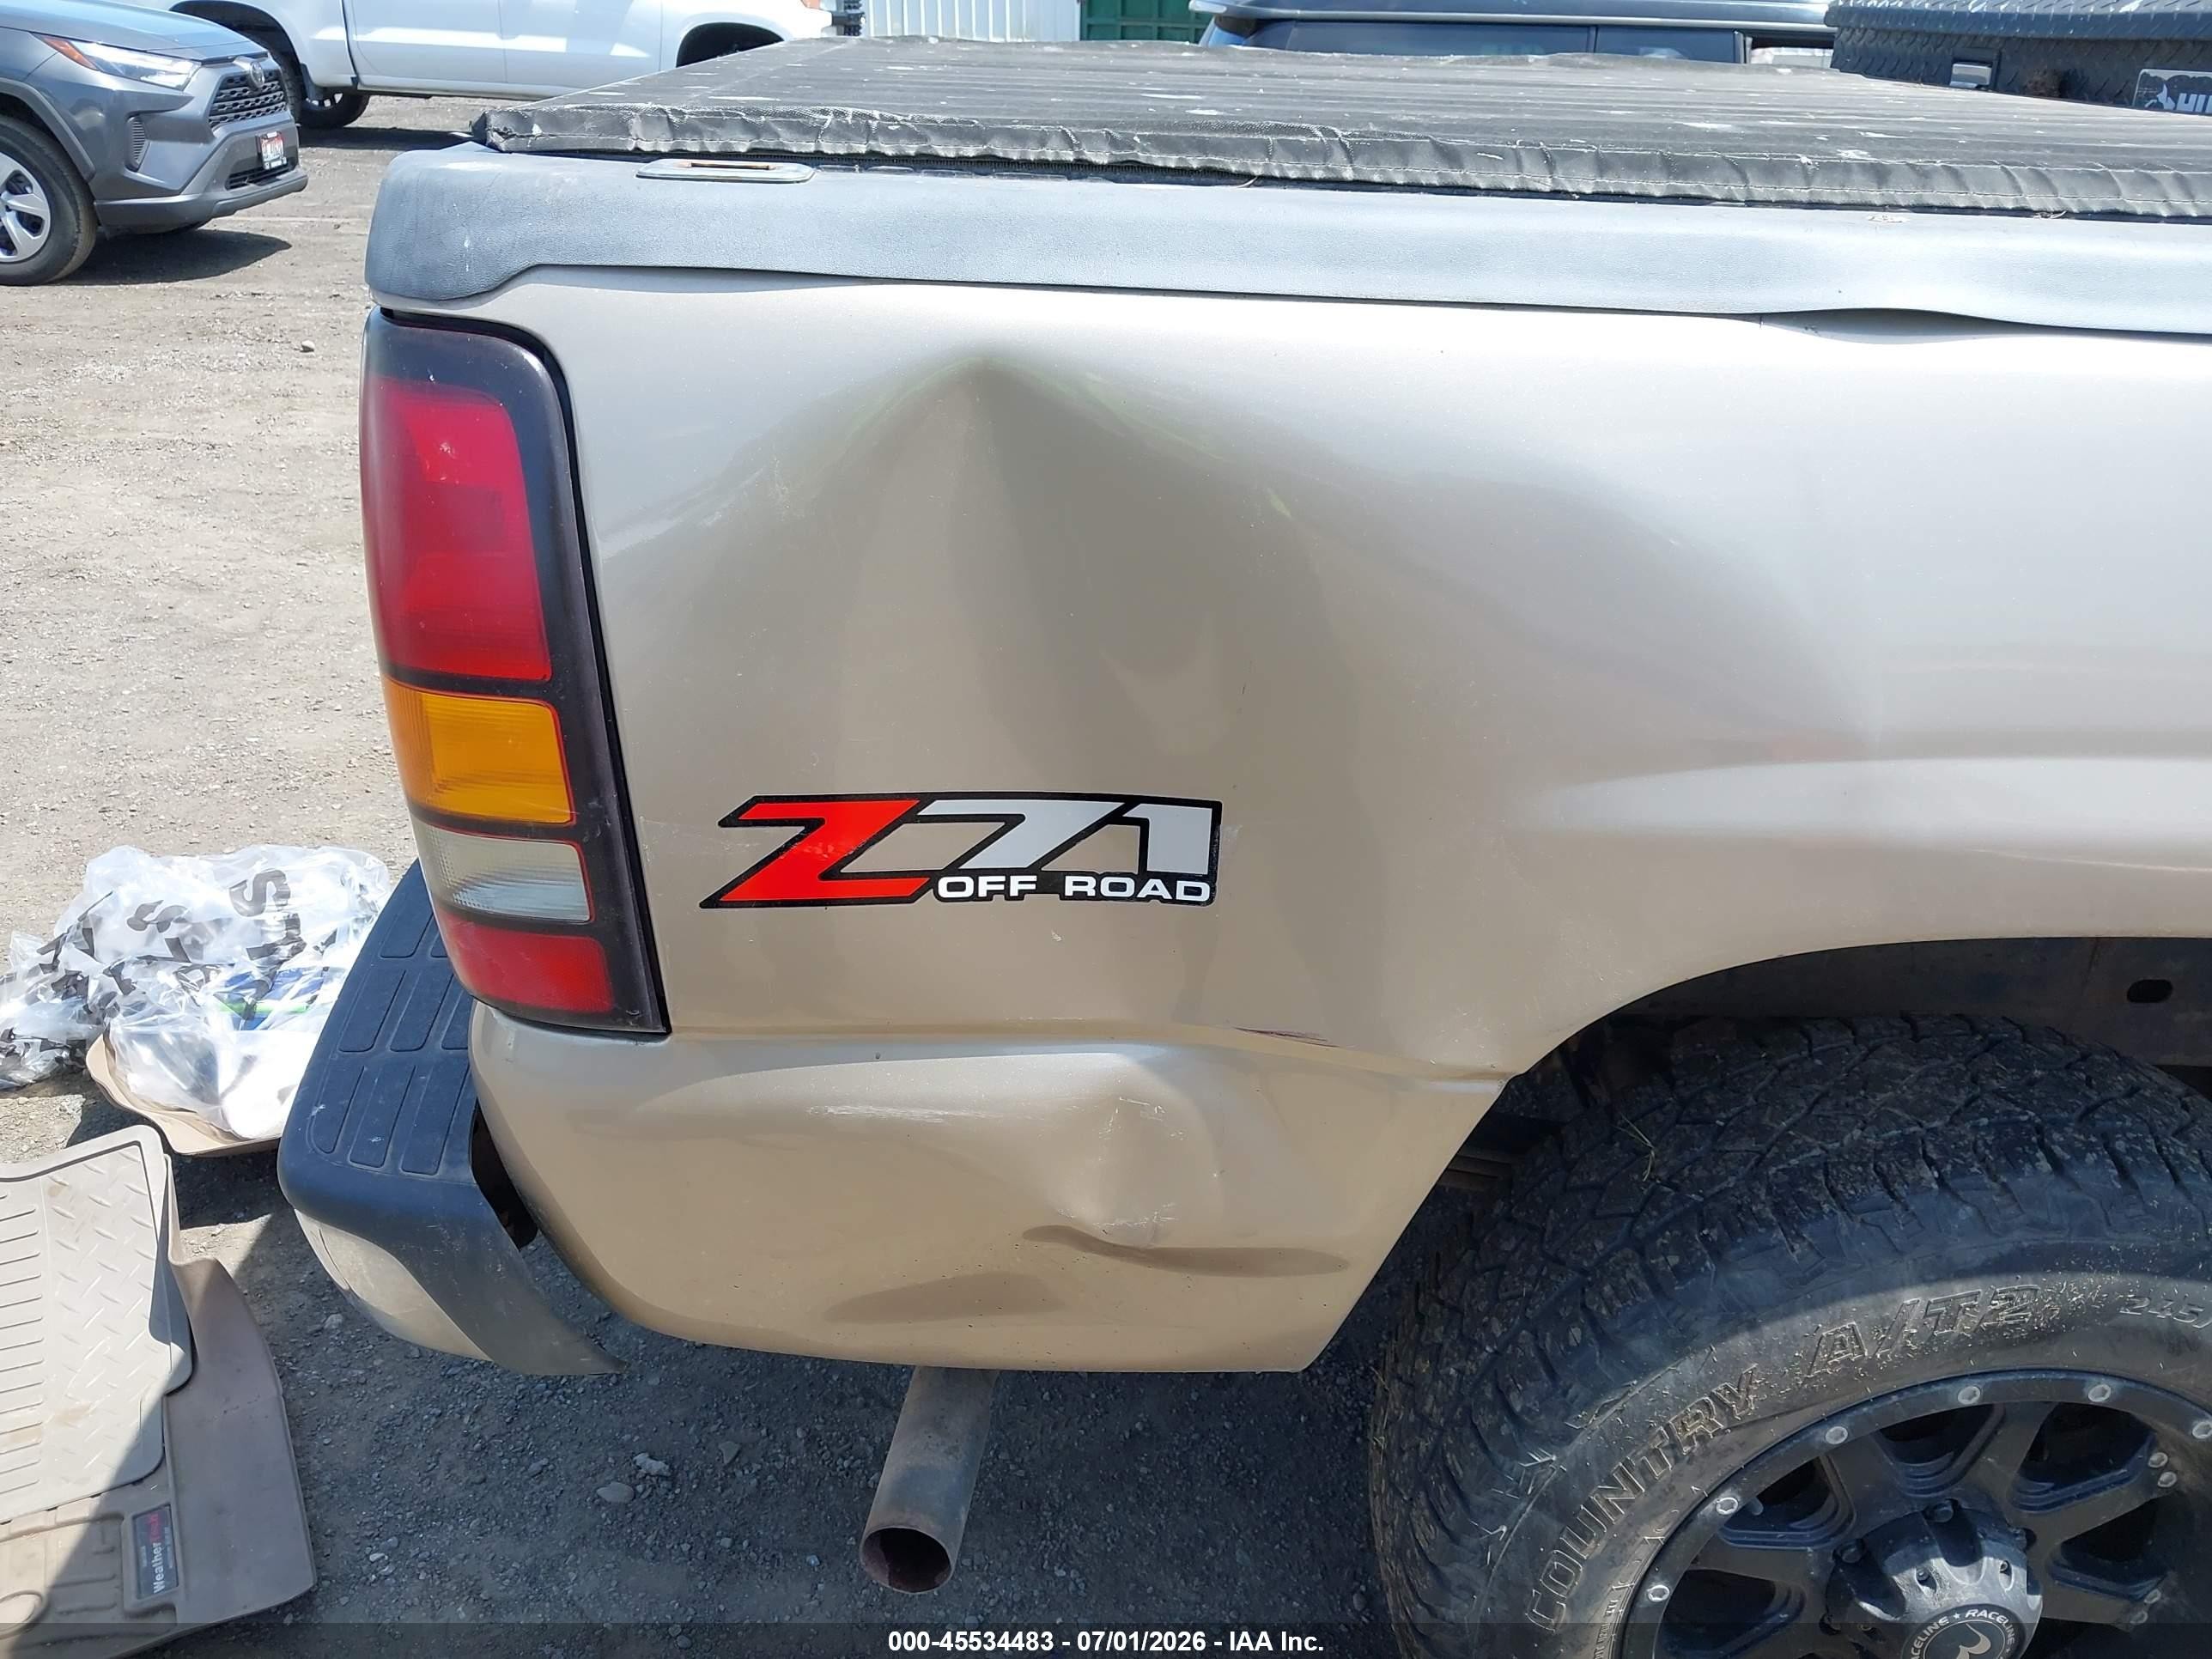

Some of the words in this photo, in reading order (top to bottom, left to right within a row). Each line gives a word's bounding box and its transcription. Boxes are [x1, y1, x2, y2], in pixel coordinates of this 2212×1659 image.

[700, 792, 1222, 908] Z71
[937, 875, 1037, 898] OFF
[1064, 876, 1212, 902] ROAD
[1526, 1364, 1758, 1632] COUNTRY
[1965, 1608, 2015, 1645] RACELINE
